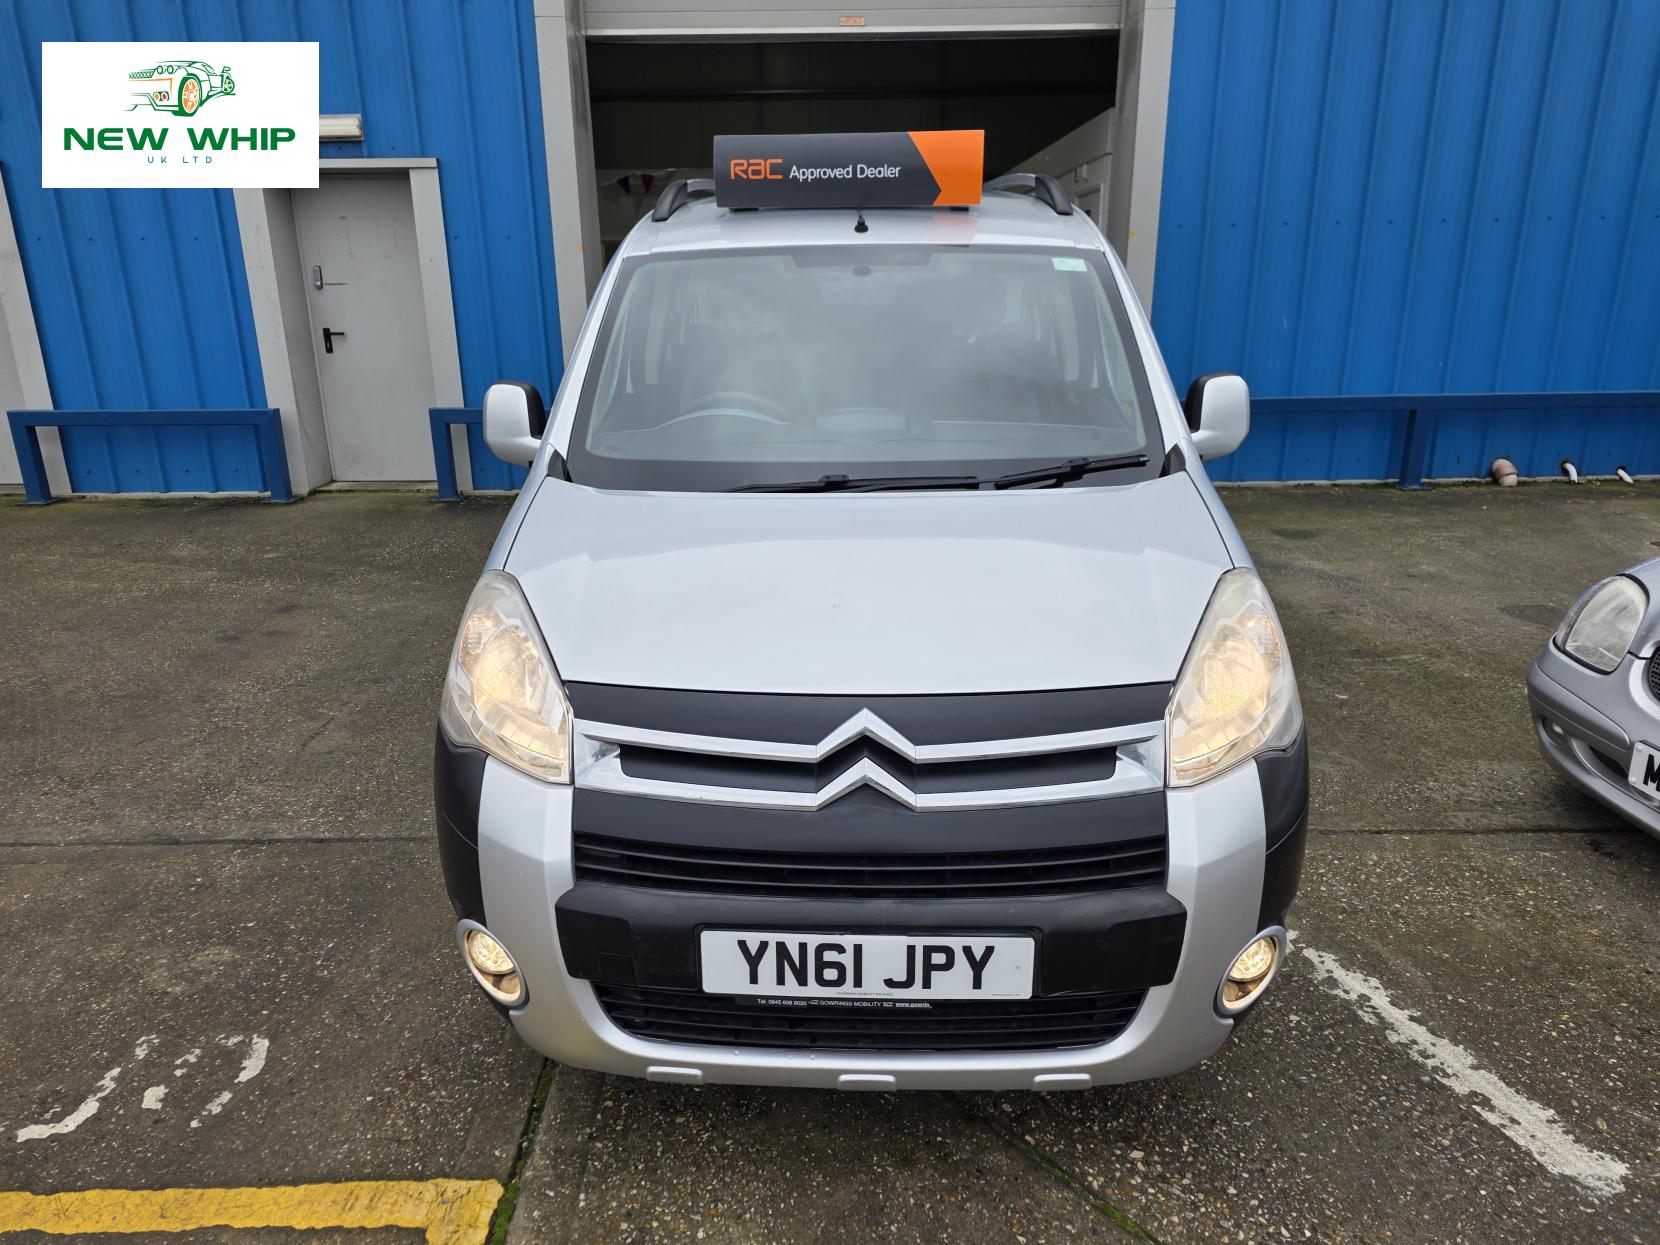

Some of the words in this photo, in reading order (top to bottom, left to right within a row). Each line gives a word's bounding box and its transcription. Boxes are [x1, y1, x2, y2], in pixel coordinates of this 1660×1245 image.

[789, 164, 853, 183] Approved
[857, 163, 901, 178] Dealer
[737, 939, 863, 989] YN61
[883, 944, 996, 991] JPY
